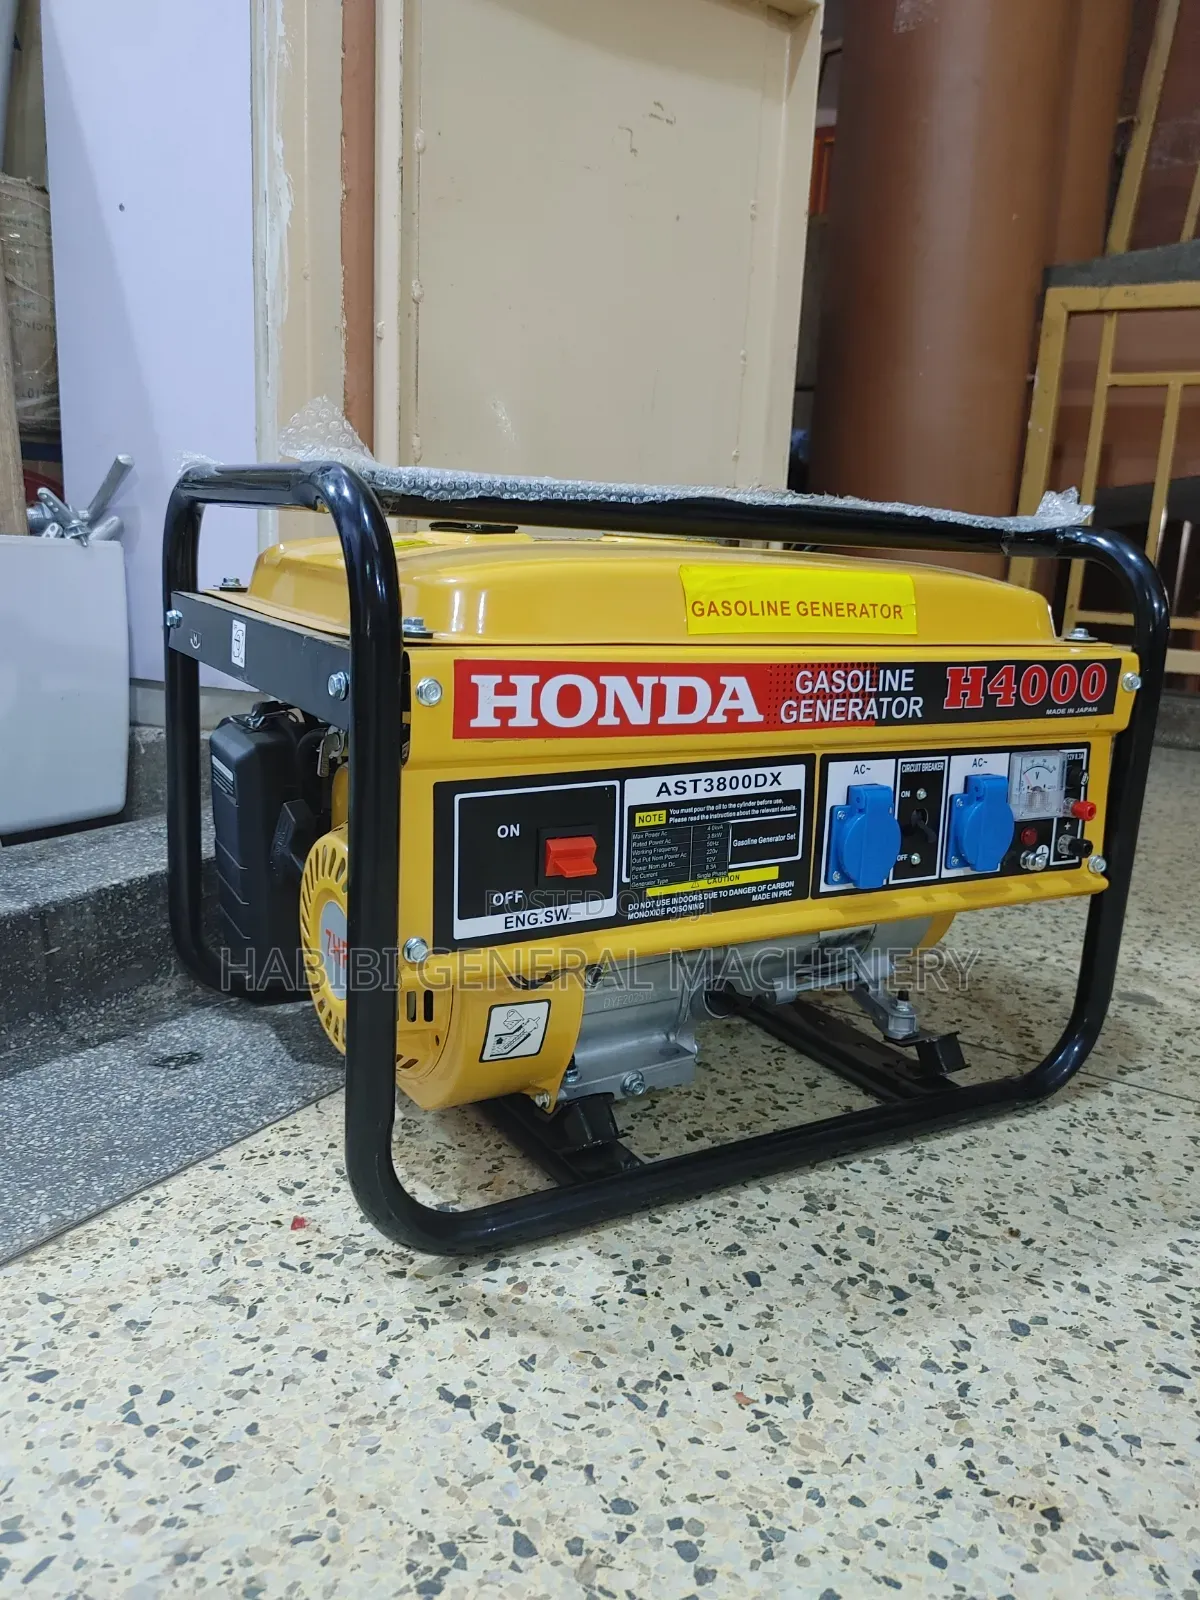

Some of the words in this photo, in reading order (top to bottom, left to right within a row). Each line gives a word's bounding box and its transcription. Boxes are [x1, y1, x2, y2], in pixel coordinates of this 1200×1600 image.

[691, 600, 791, 617] GASOLINE
[796, 601, 903, 619] GENERATOR
[795, 668, 915, 694] GASOLINE
[943, 662, 1107, 710] H4000
[469, 673, 764, 729] HONDA
[780, 696, 924, 724] GENERATOR
[1046, 707, 1066, 715] MADE
[1075, 706, 1098, 714] JAPAN
[902, 763, 922, 773] CIRCUIT
[922, 762, 944, 772] BREAKER
[1035, 771, 1040, 780] V
[656, 771, 782, 798] AST3800DX
[900, 790, 910, 798] ON
[736, 800, 756, 808] cylinder
[638, 813, 664, 824] NOTE
[668, 816, 688, 824] Please
[736, 809, 750, 817] about
[760, 806, 779, 814] relevant
[497, 823, 520, 838] ON
[733, 838, 757, 847] Gasoline
[758, 834, 786, 844] Generator
[896, 853, 908, 862] OFF
[707, 874, 740, 884] CAUTION
[492, 890, 524, 906] OFF
[640, 900, 655, 909] NOT
[656, 898, 670, 906] USE
[672, 894, 702, 904] INDOORS
[719, 889, 728, 897] TO
[729, 886, 756, 896] DANGER
[767, 880, 794, 891] CARBON
[752, 893, 770, 901] MADE
[504, 907, 572, 930] ENG.SW.
[628, 908, 666, 920] MONOXIDE
[666, 902, 704, 914] POISONING
